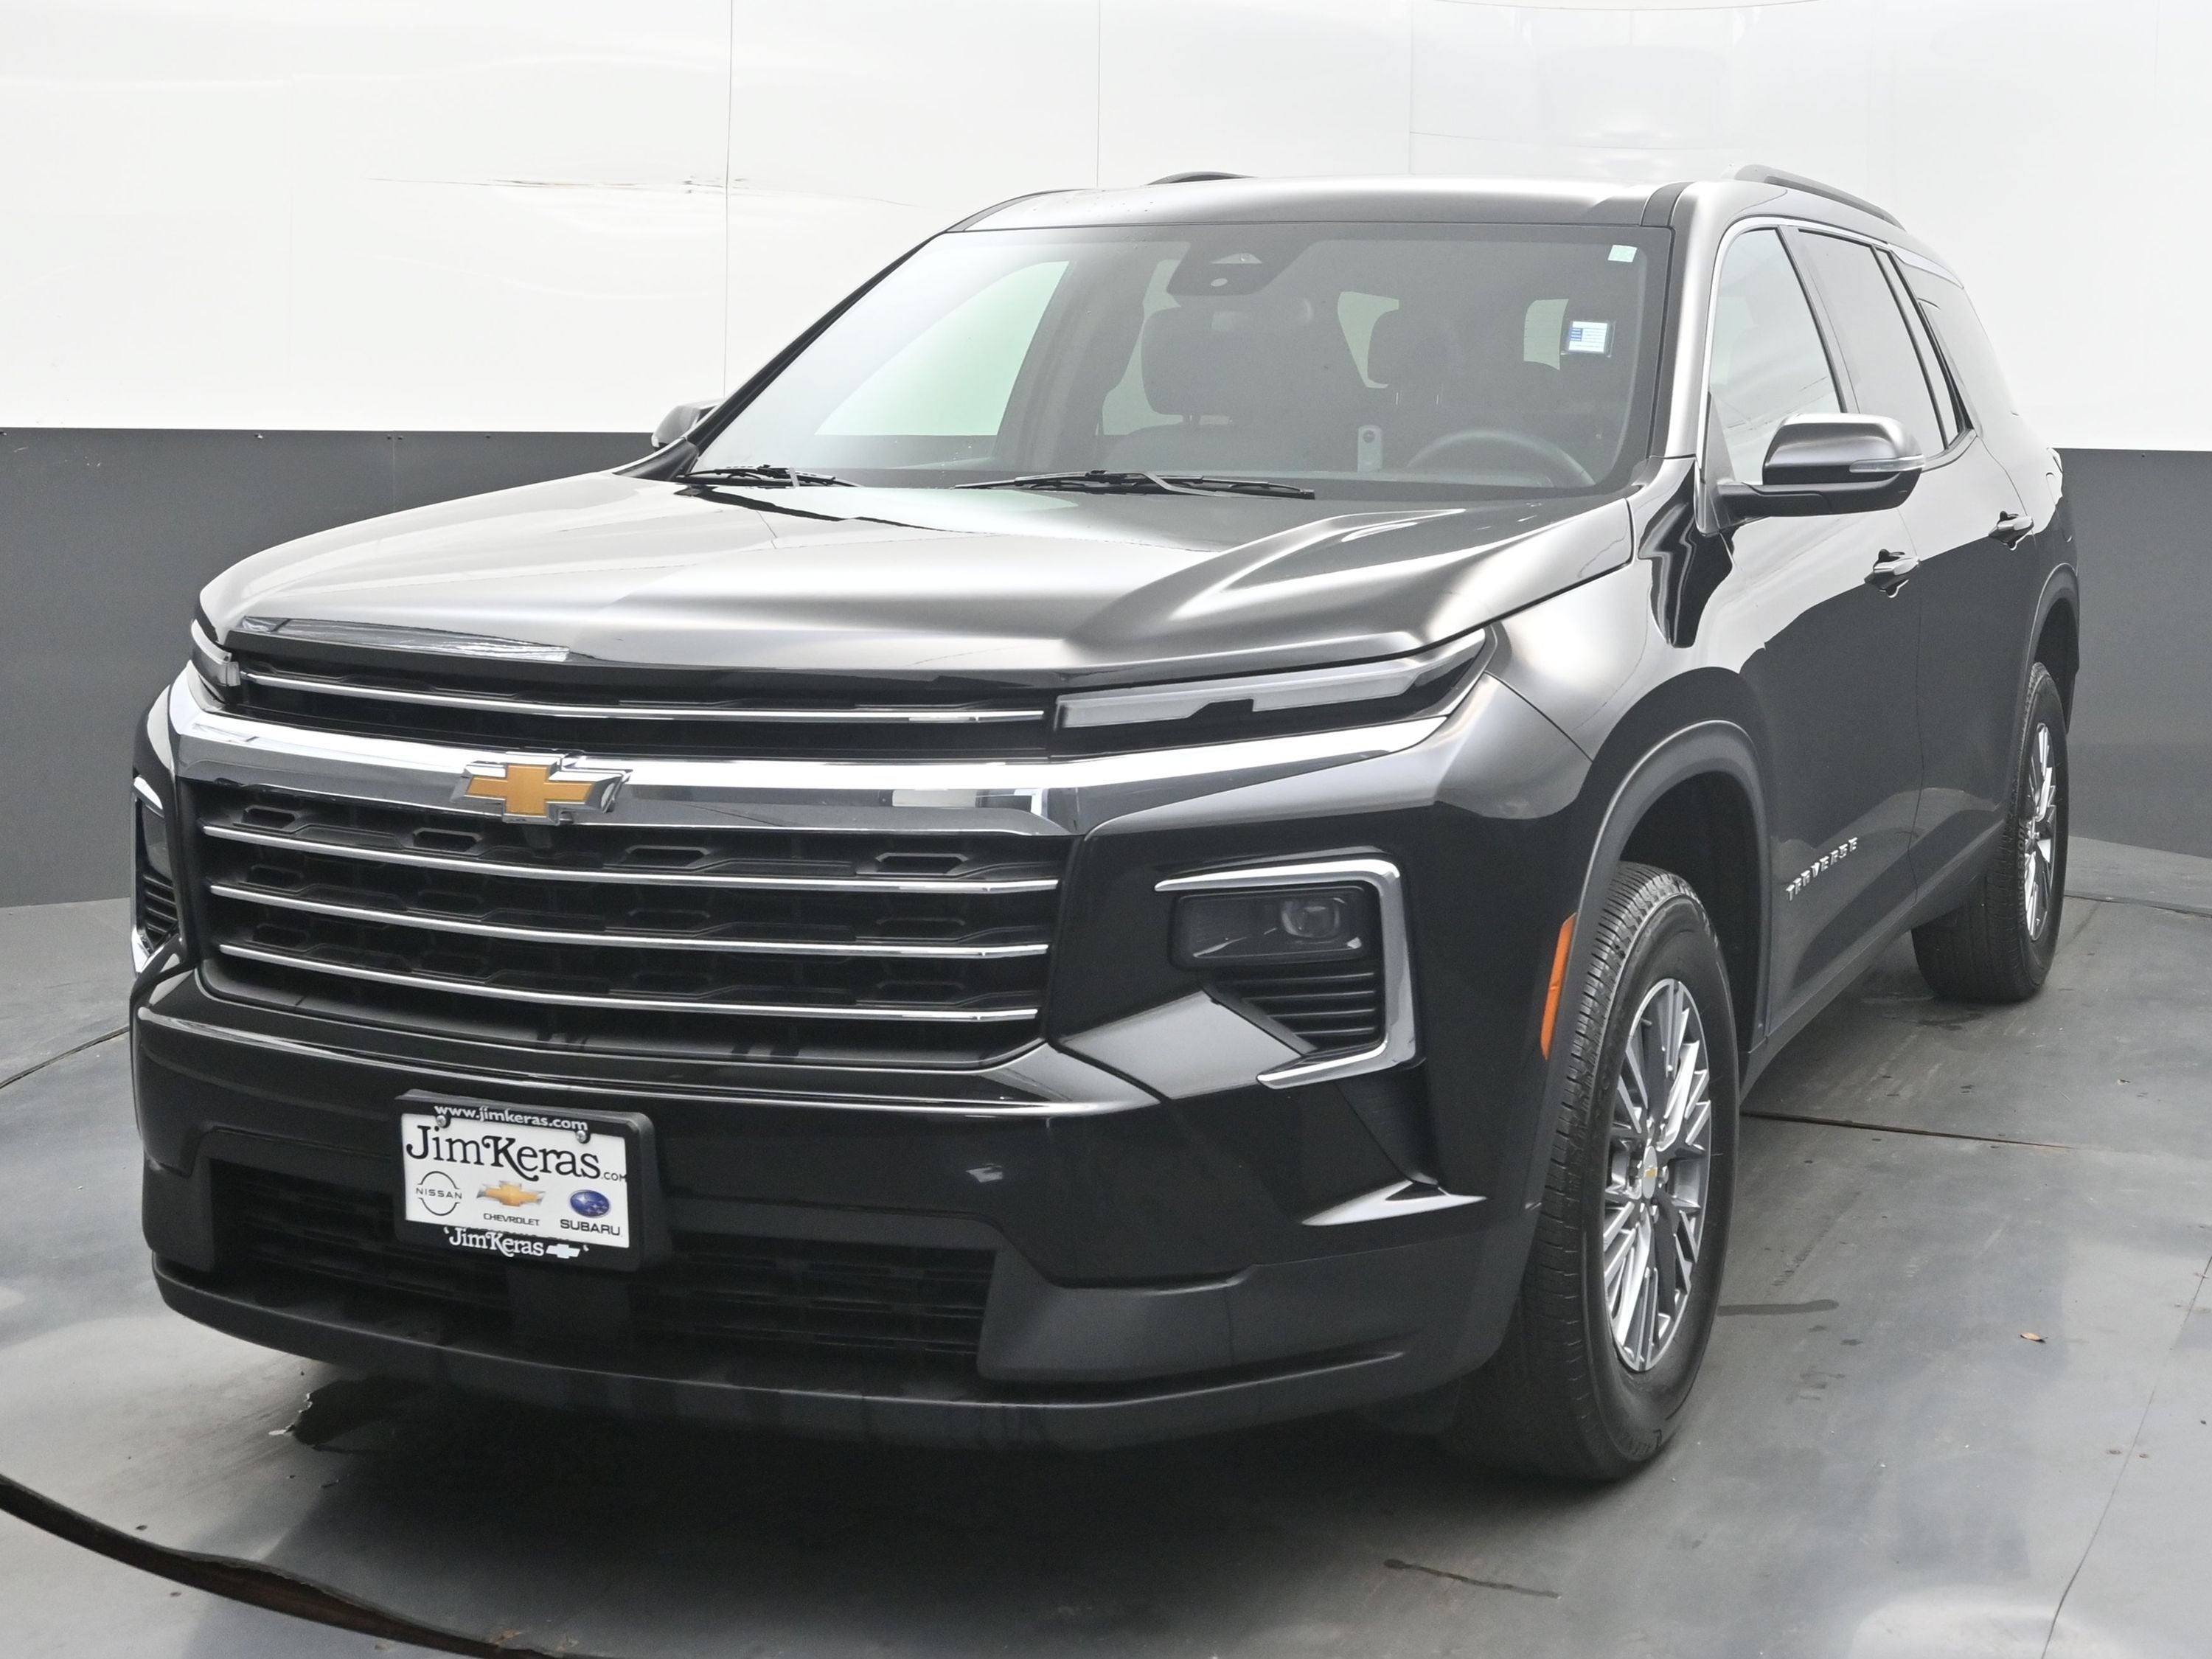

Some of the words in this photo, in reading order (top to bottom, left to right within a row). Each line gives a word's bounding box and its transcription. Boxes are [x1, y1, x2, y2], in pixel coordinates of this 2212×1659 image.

[1786, 837, 1858, 901] TRAVERSE
[434, 1105, 588, 1131] www.jimkeras.com
[416, 1187, 462, 1200] NISSAN
[483, 1213, 540, 1226] CHEVROLET
[560, 1219, 621, 1236] SUBARU
